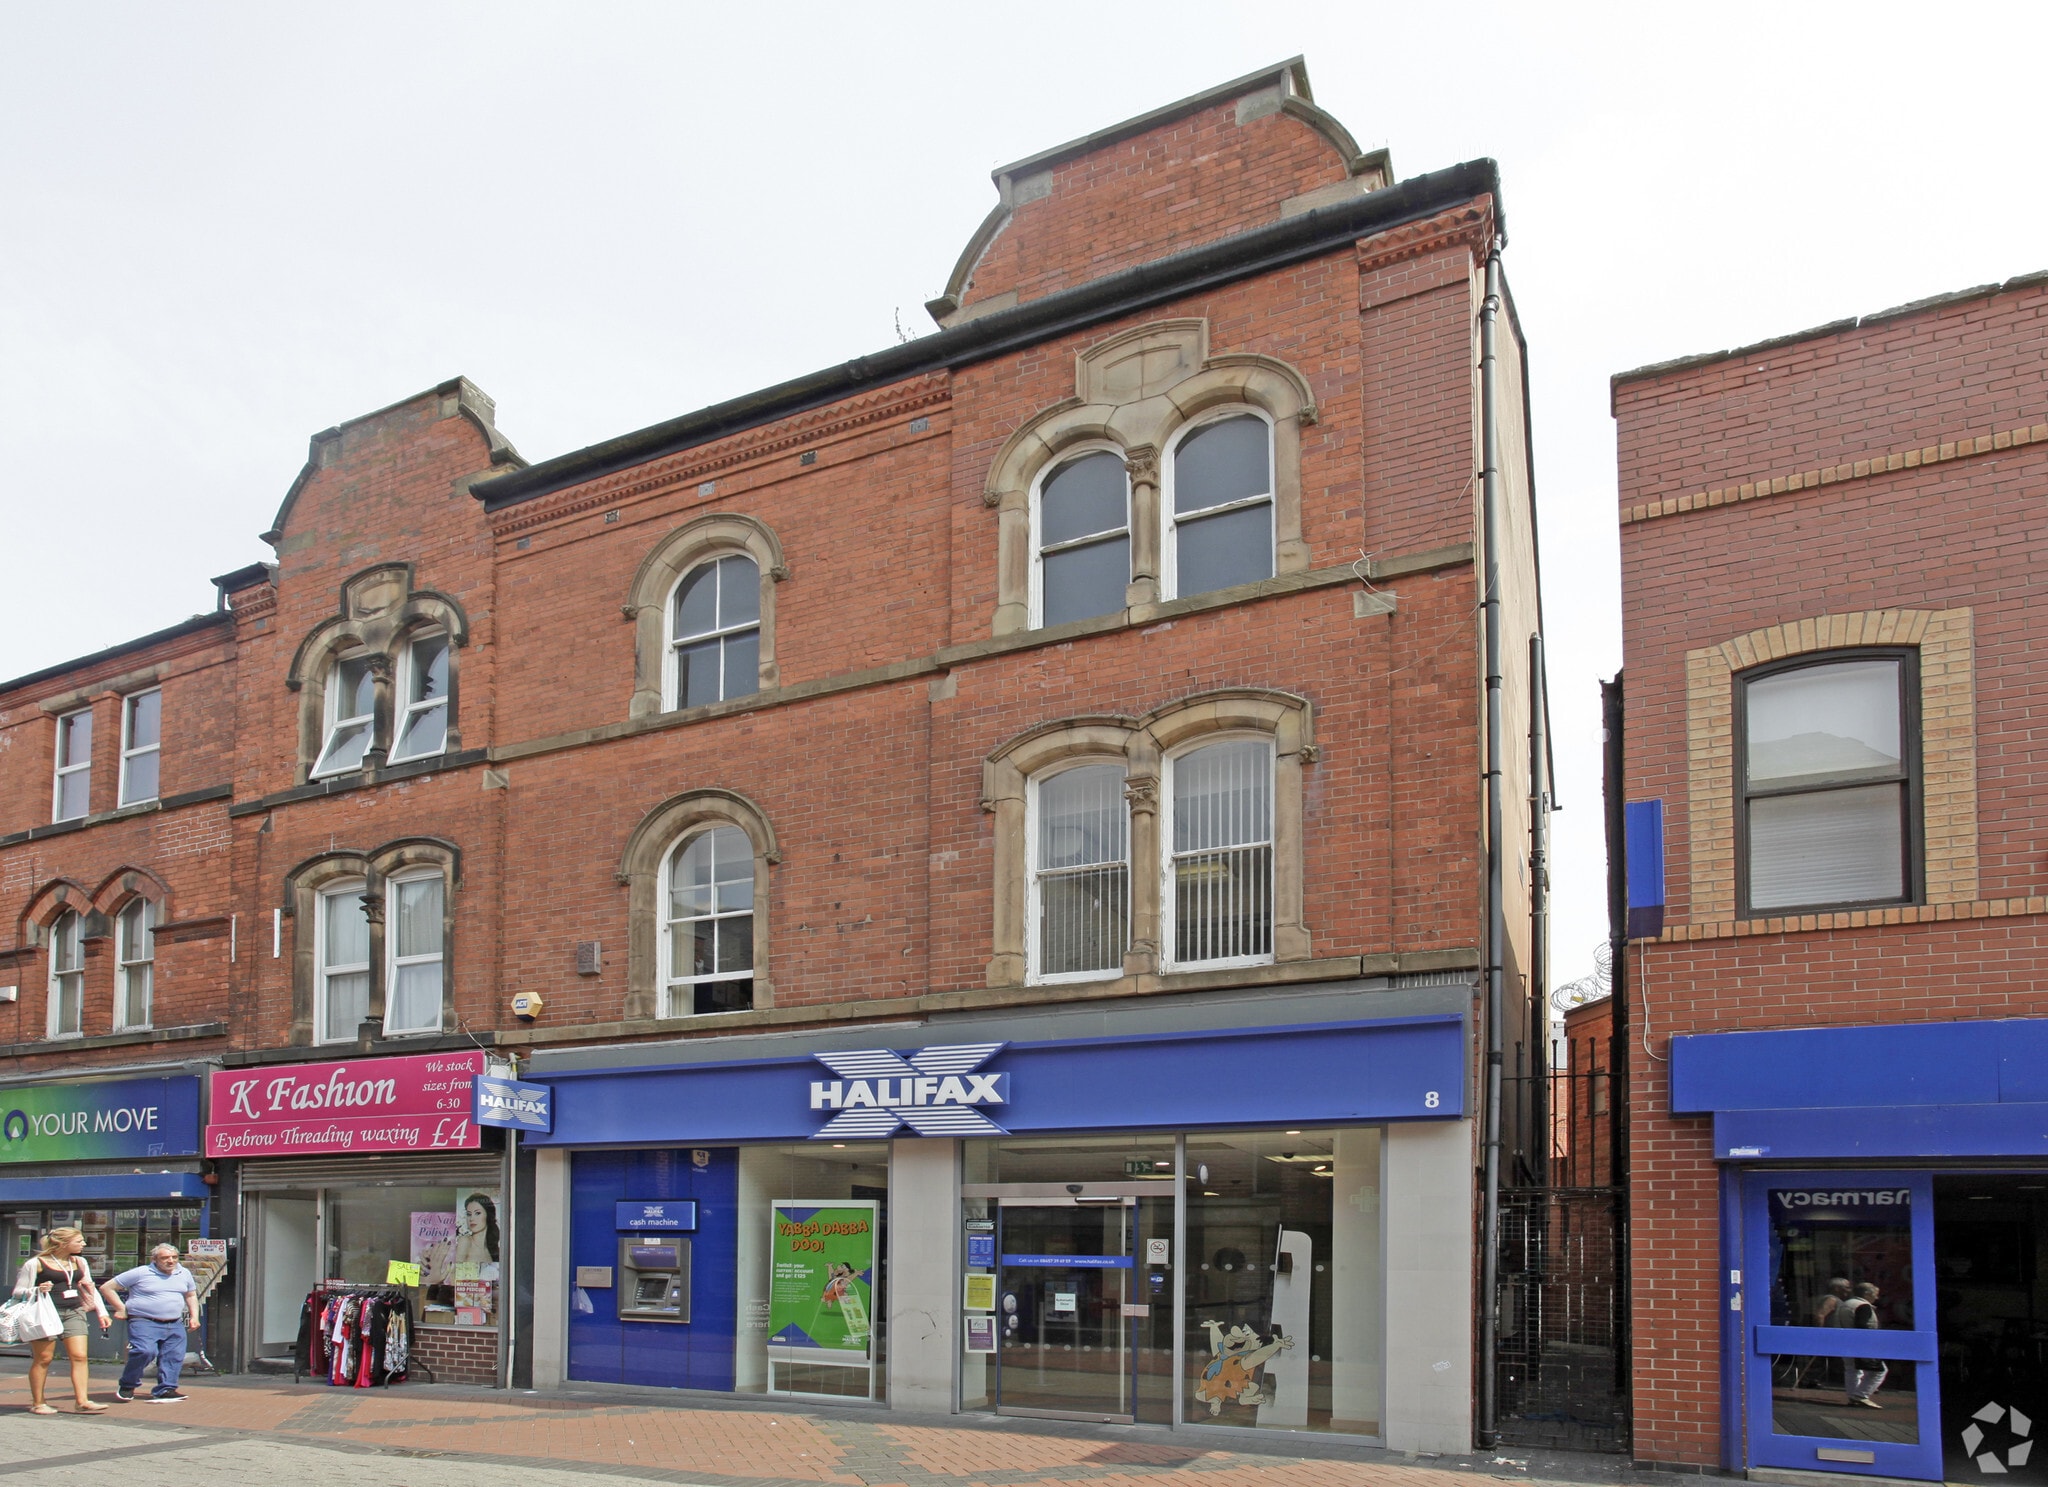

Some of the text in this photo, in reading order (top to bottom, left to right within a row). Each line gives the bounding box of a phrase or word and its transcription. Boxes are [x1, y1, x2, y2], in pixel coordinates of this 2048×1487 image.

[425, 1057, 475, 1072] We stock
[229, 1067, 397, 1119] K Fashion
[422, 1077, 473, 1094] sizes from
[810, 1073, 1004, 1109] HALIFAX
[436, 1098, 461, 1110] 6-30
[480, 1094, 548, 1115] HALIFAX
[1425, 1091, 1440, 1108] 8
[31, 1106, 158, 1137] YOUR MOVE
[215, 1117, 468, 1152] Eyebrow Threading waxing £4
[629, 1218, 679, 1226] cash machine
[778, 1220, 869, 1237] YABBA DABBA
[418, 1226, 450, 1237] Polish
[790, 1239, 825, 1253] DOO!
